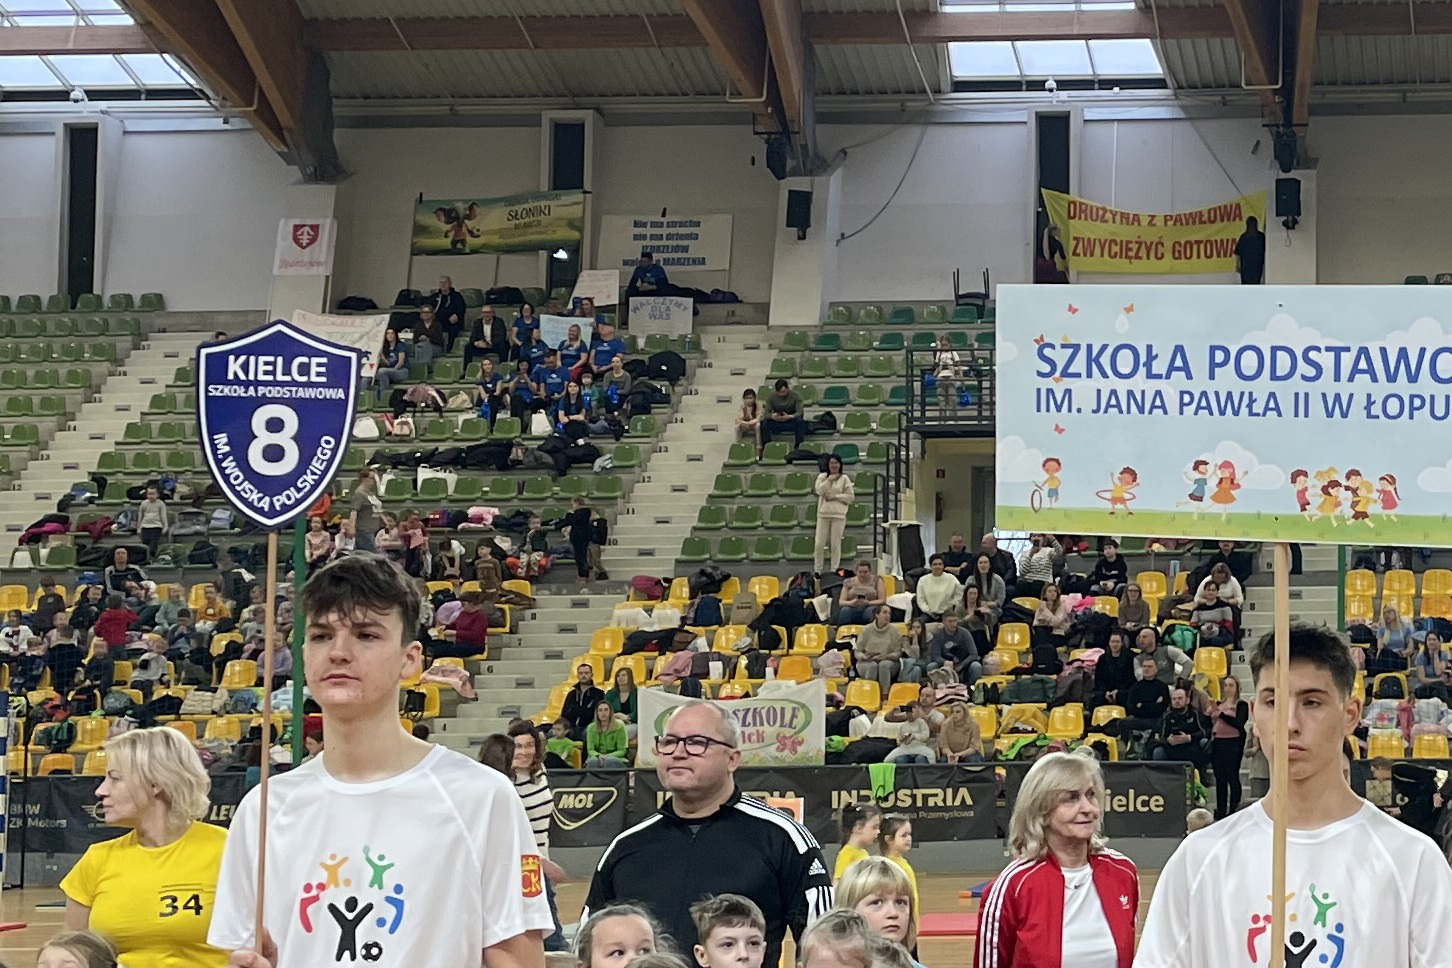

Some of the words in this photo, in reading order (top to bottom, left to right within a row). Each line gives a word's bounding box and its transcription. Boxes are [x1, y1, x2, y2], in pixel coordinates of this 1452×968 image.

[506, 205, 552, 222] SŁONIKI
[1067, 200, 1142, 227] DRUŻYNA
[1148, 214, 1157, 227] Z
[1163, 202, 1244, 228] PAWŁOWA
[1071, 235, 1165, 264] ZWYCIĘŻYĆ
[650, 305, 672, 313] DLA
[226, 355, 329, 383] KIELCE
[1035, 342, 1194, 381] SZKOŁA
[207, 384, 256, 398] SZKOŁA
[257, 385, 346, 400] PODSTAWOWA
[1035, 387, 1083, 415] IM.
[1092, 388, 1169, 417] JANA
[1178, 390, 1284, 418] PAWŁA
[1293, 391, 1311, 419] II
[1320, 392, 1356, 419] W
[247, 403, 300, 477] 8
[212, 432, 228, 459] IM.
[220, 455, 271, 512] WOJSKA
[272, 435, 336, 512] POLSKIEGO
[558, 793, 595, 810] MOL
[1104, 788, 1165, 813] ielce
[158, 893, 204, 918] 34
